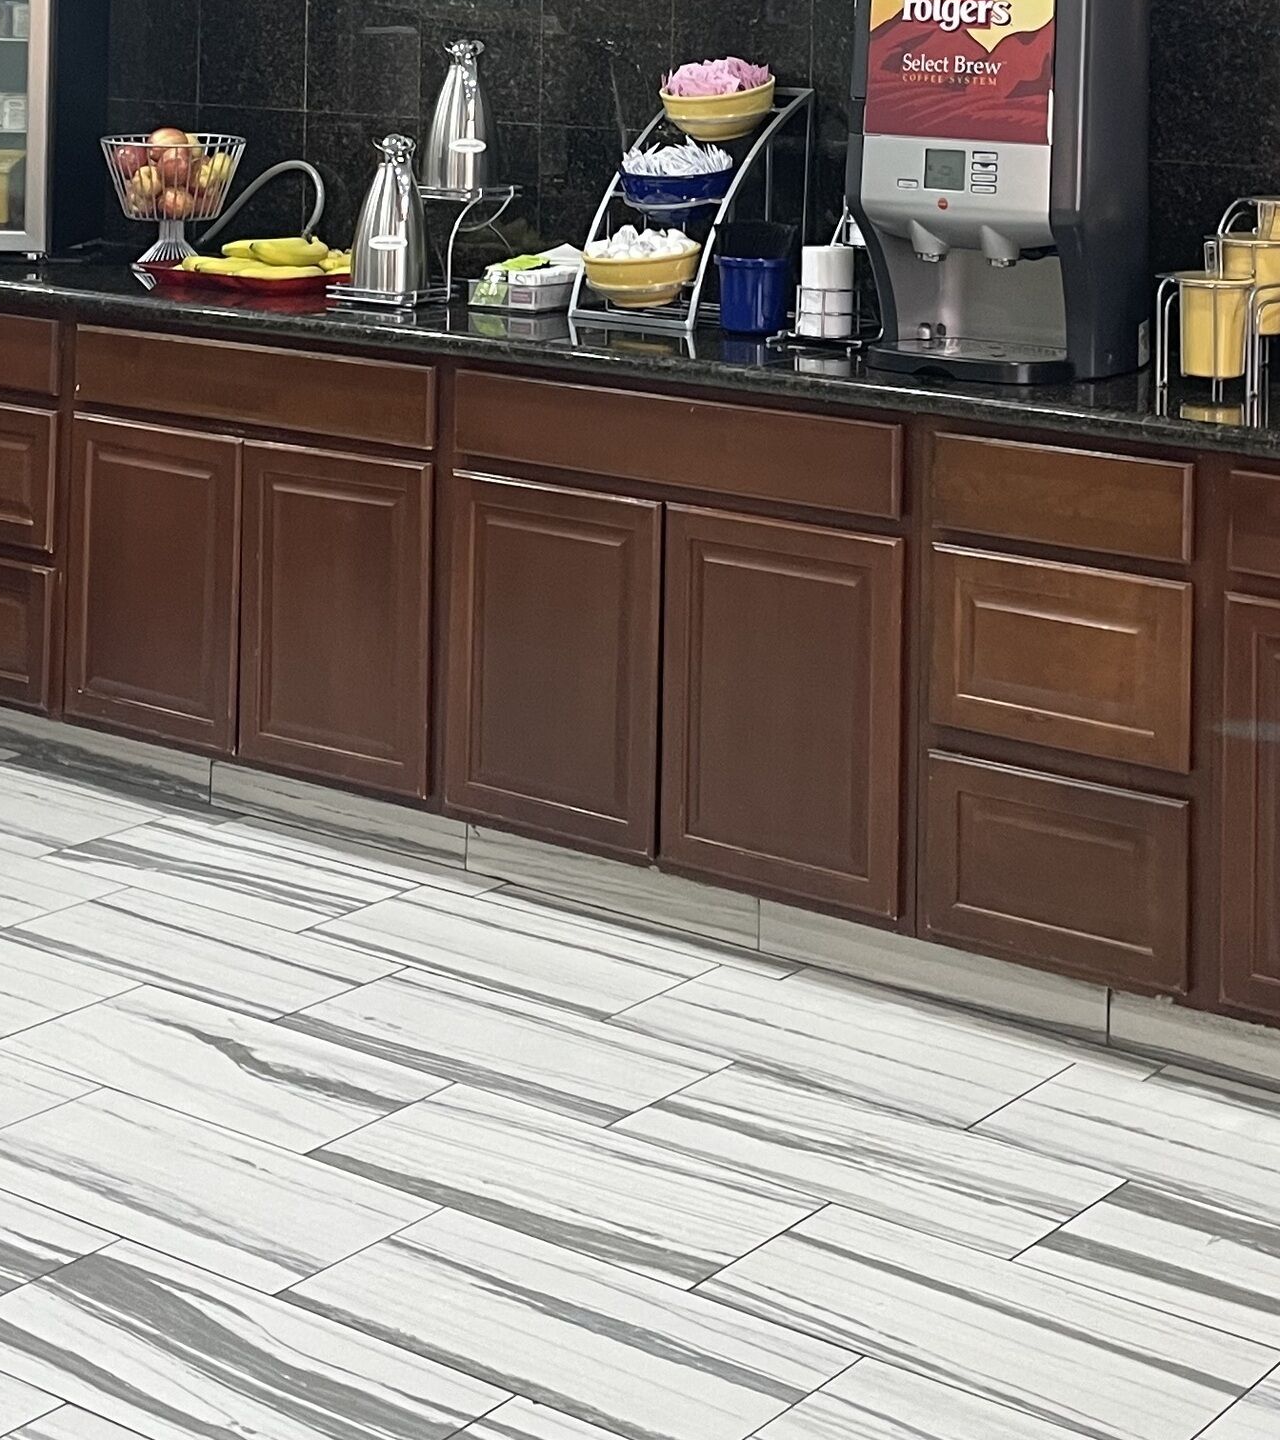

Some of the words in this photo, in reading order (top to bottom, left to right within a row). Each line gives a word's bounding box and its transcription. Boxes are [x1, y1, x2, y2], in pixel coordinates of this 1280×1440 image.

[903, 53, 949, 72] Select
[902, 74, 944, 83] COFFEE
[949, 76, 997, 85] SYSTEM
